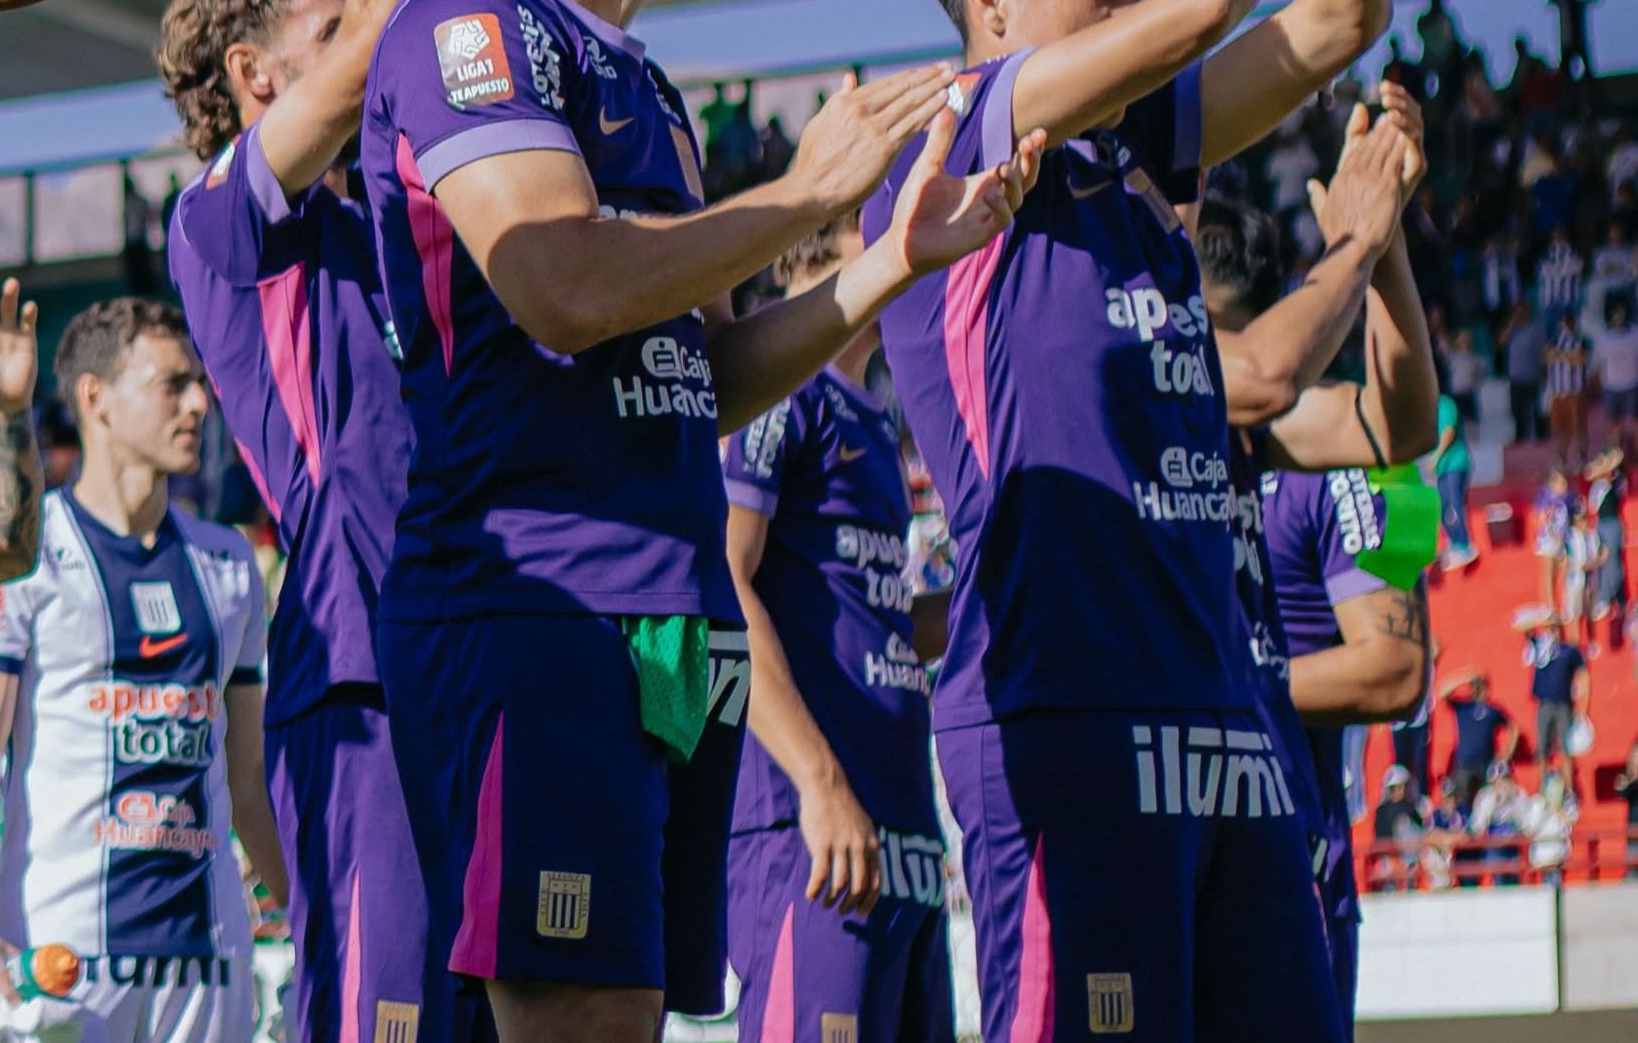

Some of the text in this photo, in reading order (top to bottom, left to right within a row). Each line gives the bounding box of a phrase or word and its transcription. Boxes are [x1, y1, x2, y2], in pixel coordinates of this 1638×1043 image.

[456, 58, 494, 82] LIGA1
[1105, 286, 1209, 342] apes
[612, 375, 718, 419] Huanc
[1190, 452, 1228, 489] Caja
[1133, 481, 1230, 533] Huanca
[117, 720, 210, 764] total
[1132, 725, 1296, 818] ilumi
